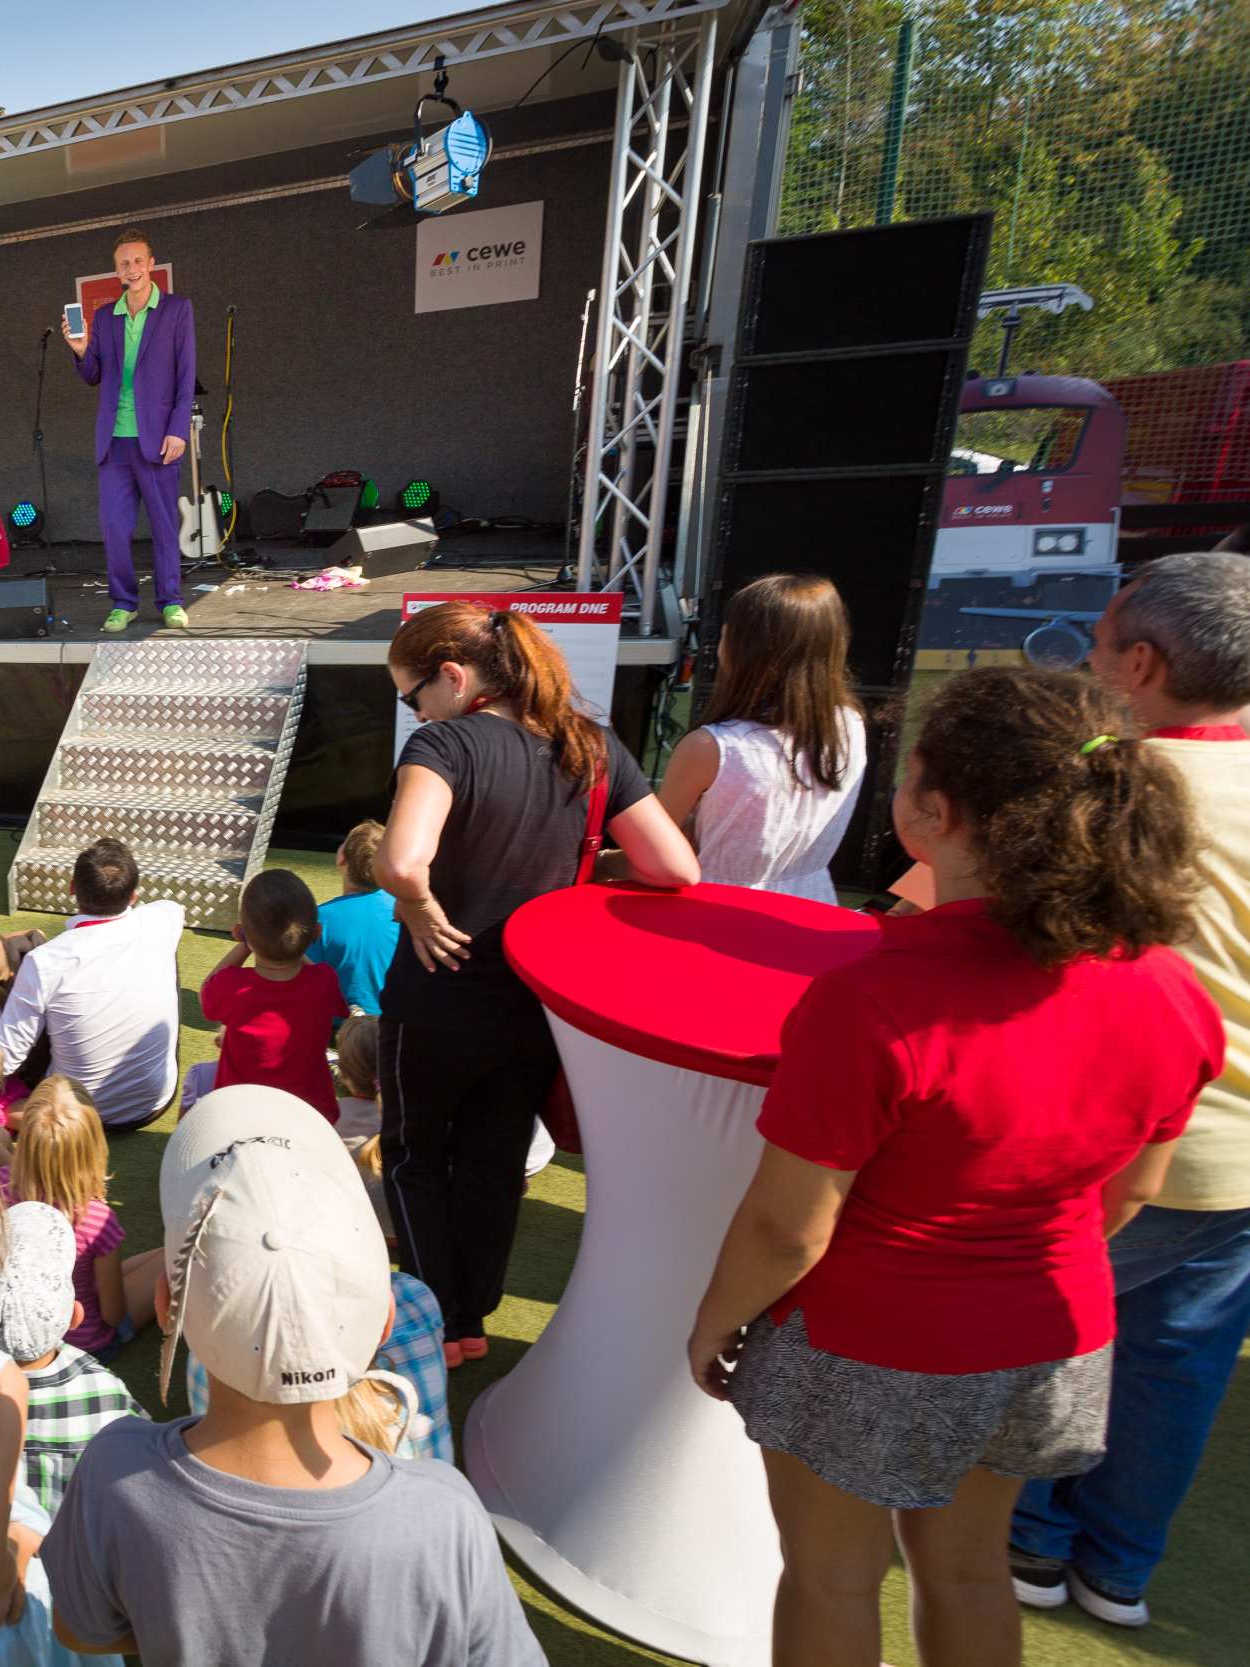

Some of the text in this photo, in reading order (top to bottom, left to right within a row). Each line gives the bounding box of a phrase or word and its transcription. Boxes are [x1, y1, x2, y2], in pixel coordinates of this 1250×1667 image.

[467, 240, 526, 261] cewe
[429, 257, 526, 278] BEST IN PRINT
[510, 603, 609, 614] PROGRAM DNE
[281, 1367, 336, 1386] Nikon
